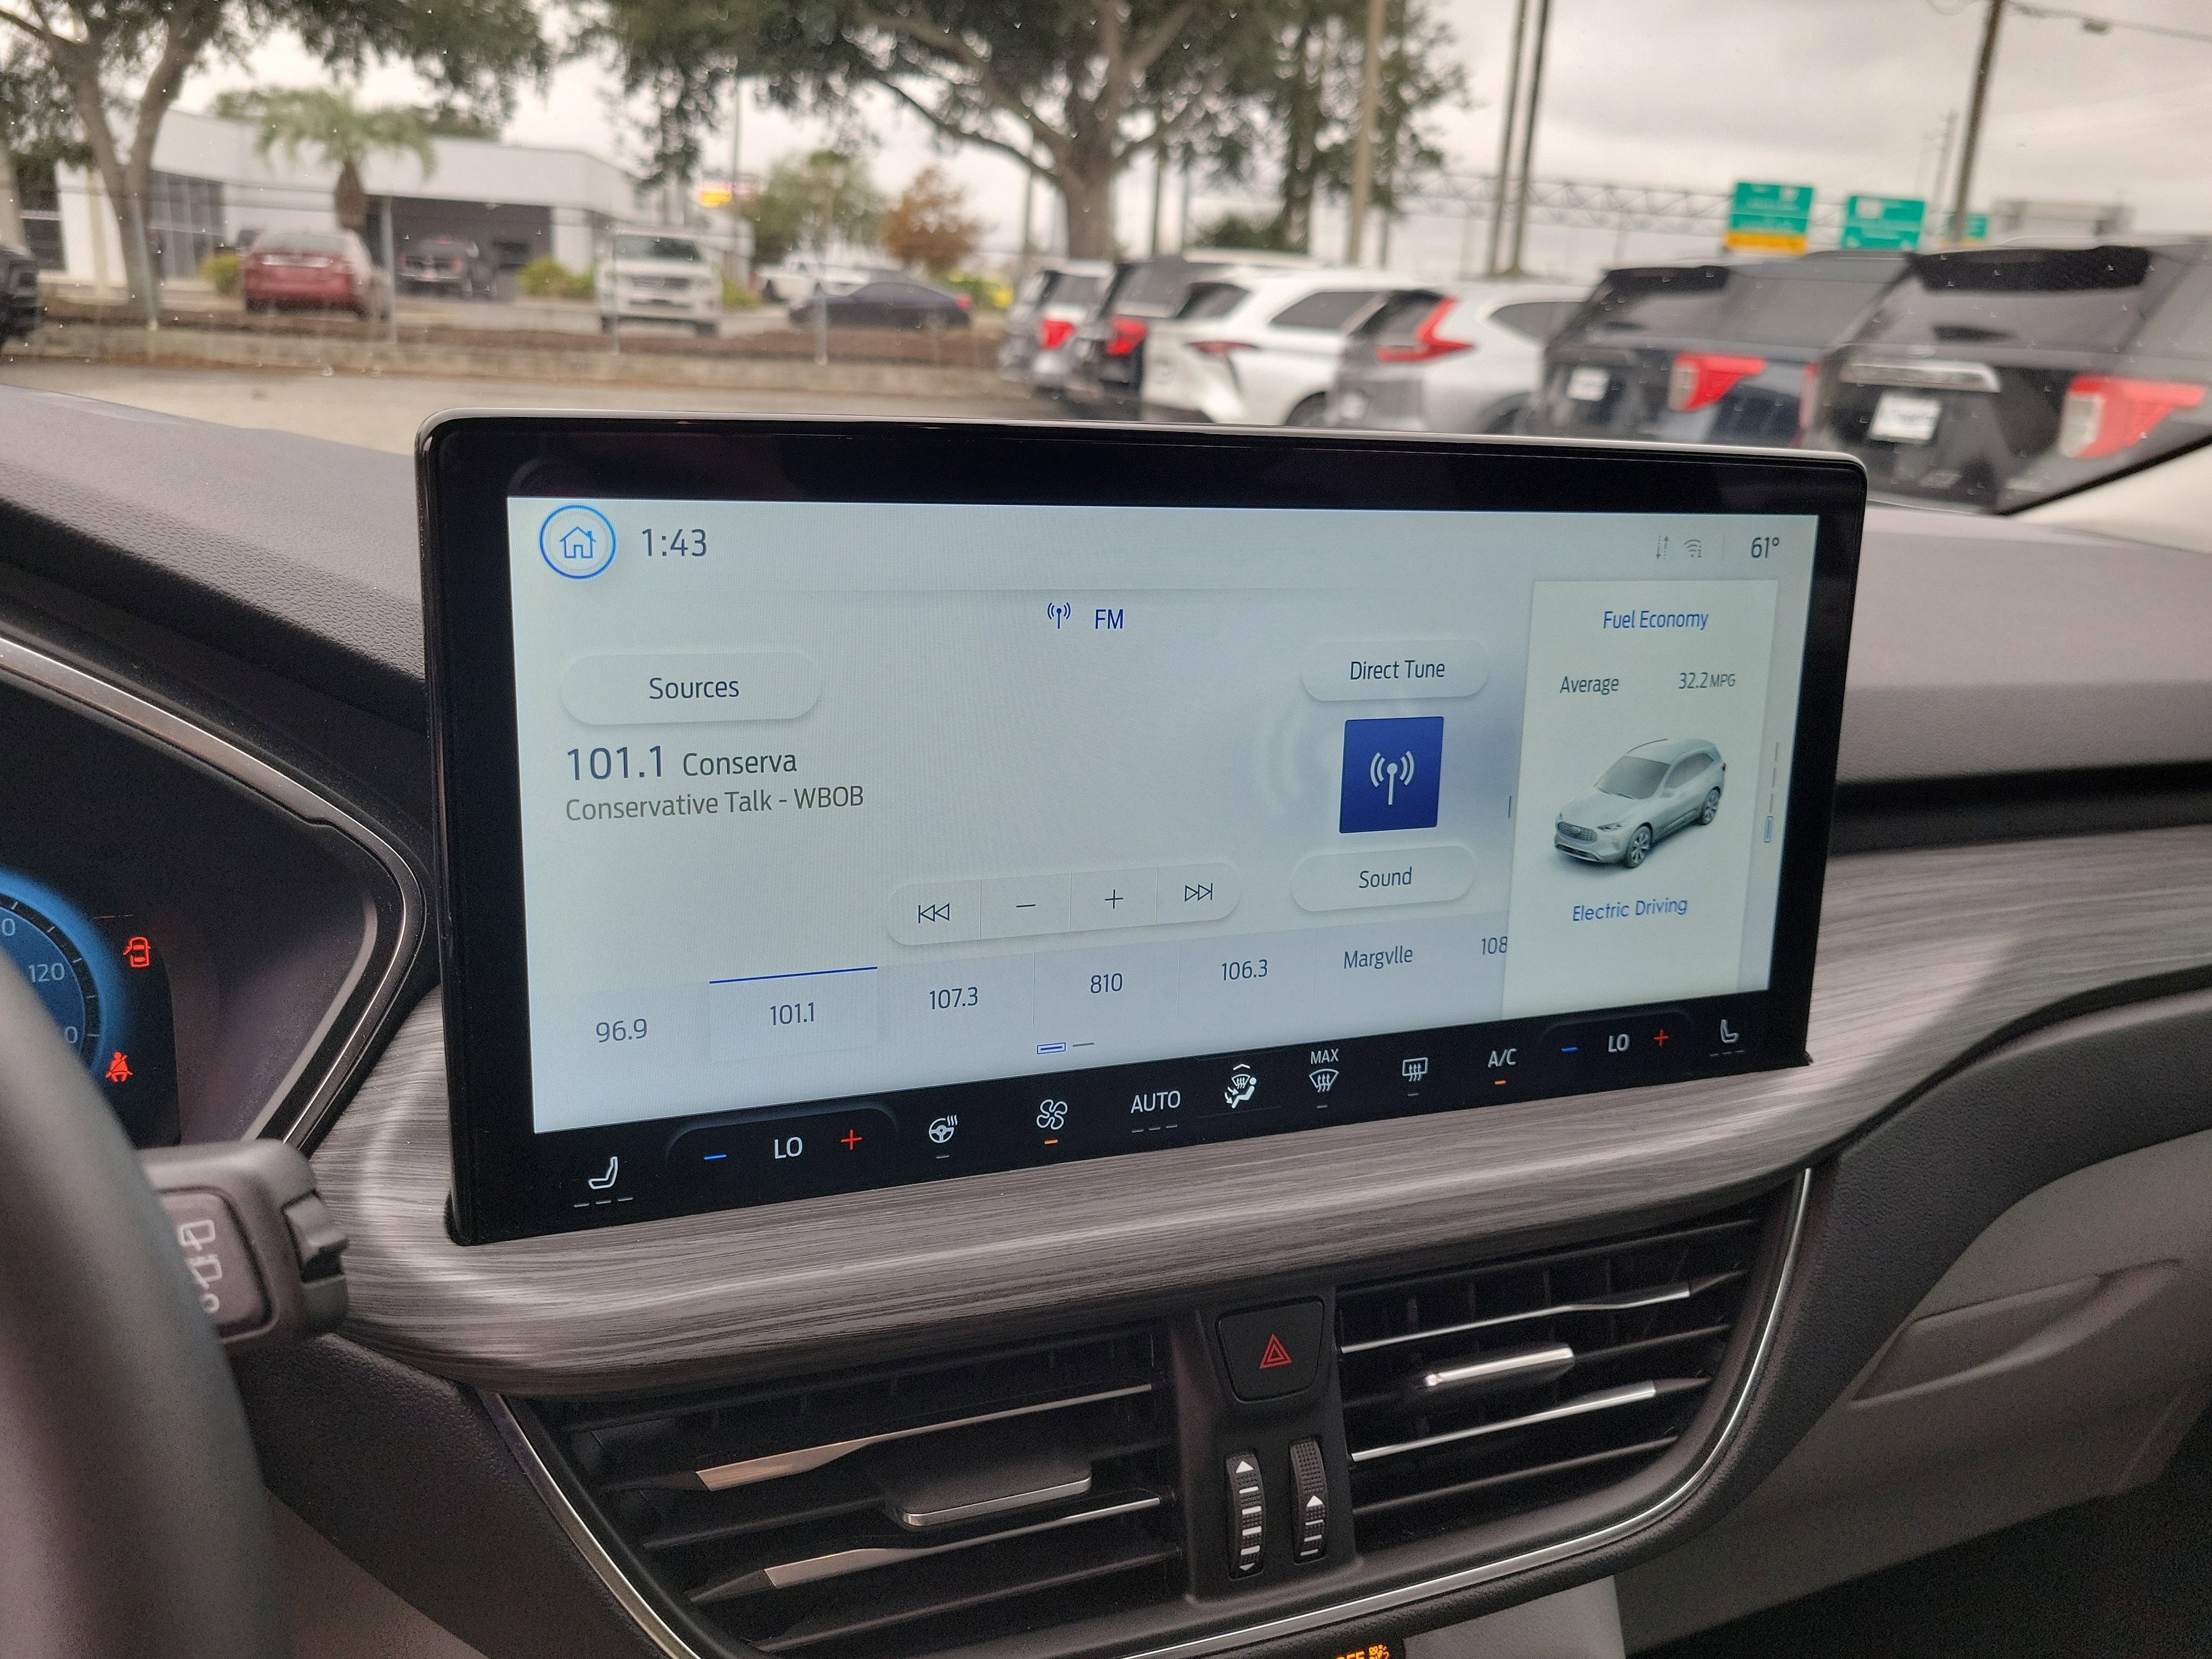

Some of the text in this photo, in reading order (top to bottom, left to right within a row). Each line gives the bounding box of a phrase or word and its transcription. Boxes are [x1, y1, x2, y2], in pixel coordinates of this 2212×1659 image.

[641, 528, 707, 557] 1:43
[1751, 537, 1780, 558] 61°
[1095, 609, 1124, 629] FM
[1603, 610, 1709, 631] Fuel Economy
[1350, 659, 1446, 680] Direct Tune
[649, 677, 740, 700] Sources
[1560, 676, 1619, 696] Average
[567, 745, 798, 781] 101.1 Conserva
[566, 793, 719, 821] Conservative
[724, 788, 772, 812] Talk
[793, 785, 864, 810] WBOB
[1358, 866, 1413, 889] Sound
[1572, 898, 1688, 922] Electric Driving
[1343, 945, 1413, 969] Margvlle
[28, 962, 65, 983] 120
[1221, 959, 1268, 981] 106.3
[1090, 973, 1123, 994] 810
[929, 986, 979, 1011] 107.3
[770, 1002, 815, 1025] 101.1
[595, 1018, 648, 1043] 96.9
[1607, 1034, 1630, 1053] LO
[1310, 1048, 1339, 1064] MAX
[1487, 1048, 1517, 1068] A/C
[1131, 1090, 1181, 1114] AUTO
[774, 1136, 803, 1160] LO
